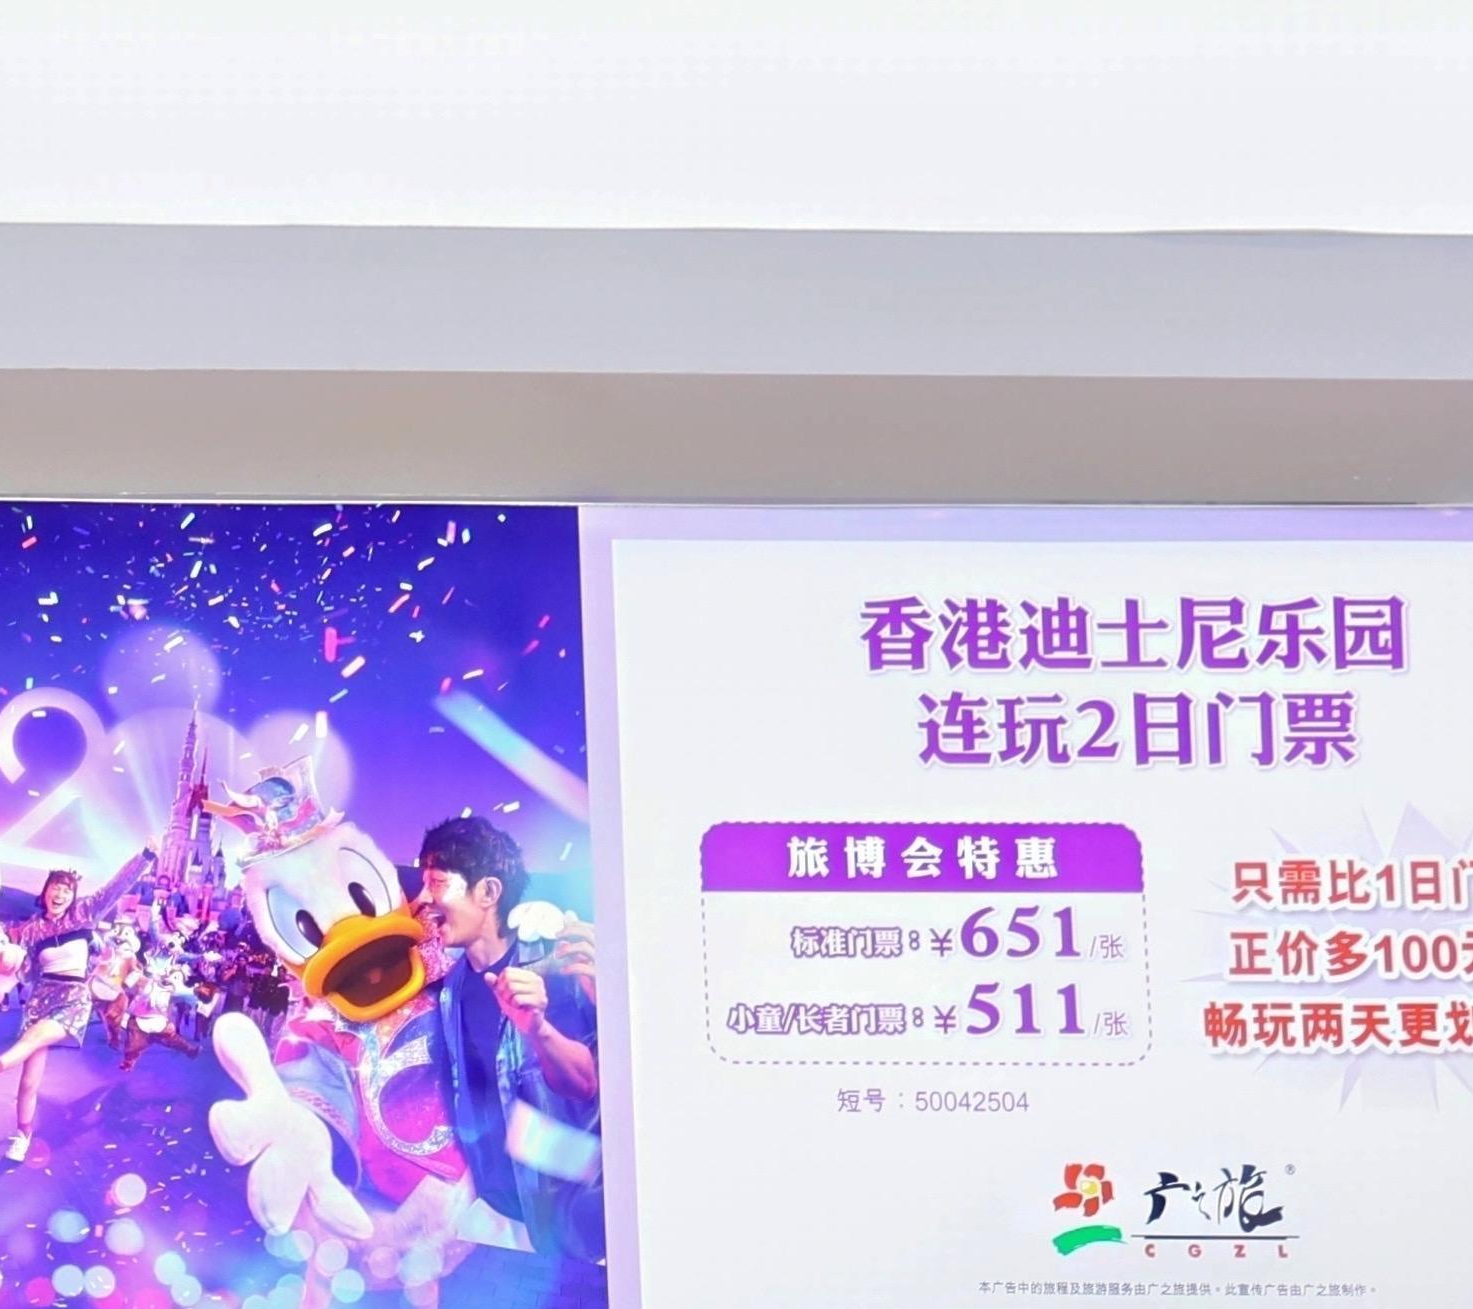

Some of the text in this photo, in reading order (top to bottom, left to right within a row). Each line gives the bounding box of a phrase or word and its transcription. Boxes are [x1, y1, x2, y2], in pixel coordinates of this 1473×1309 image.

[859, 596, 1406, 671] 香港迪士尼乐园
[917, 692, 1357, 766] 连玩2日门票
[787, 836, 1061, 881] 旅博会特惠
[1143, 1244, 1289, 1259] CGZL
